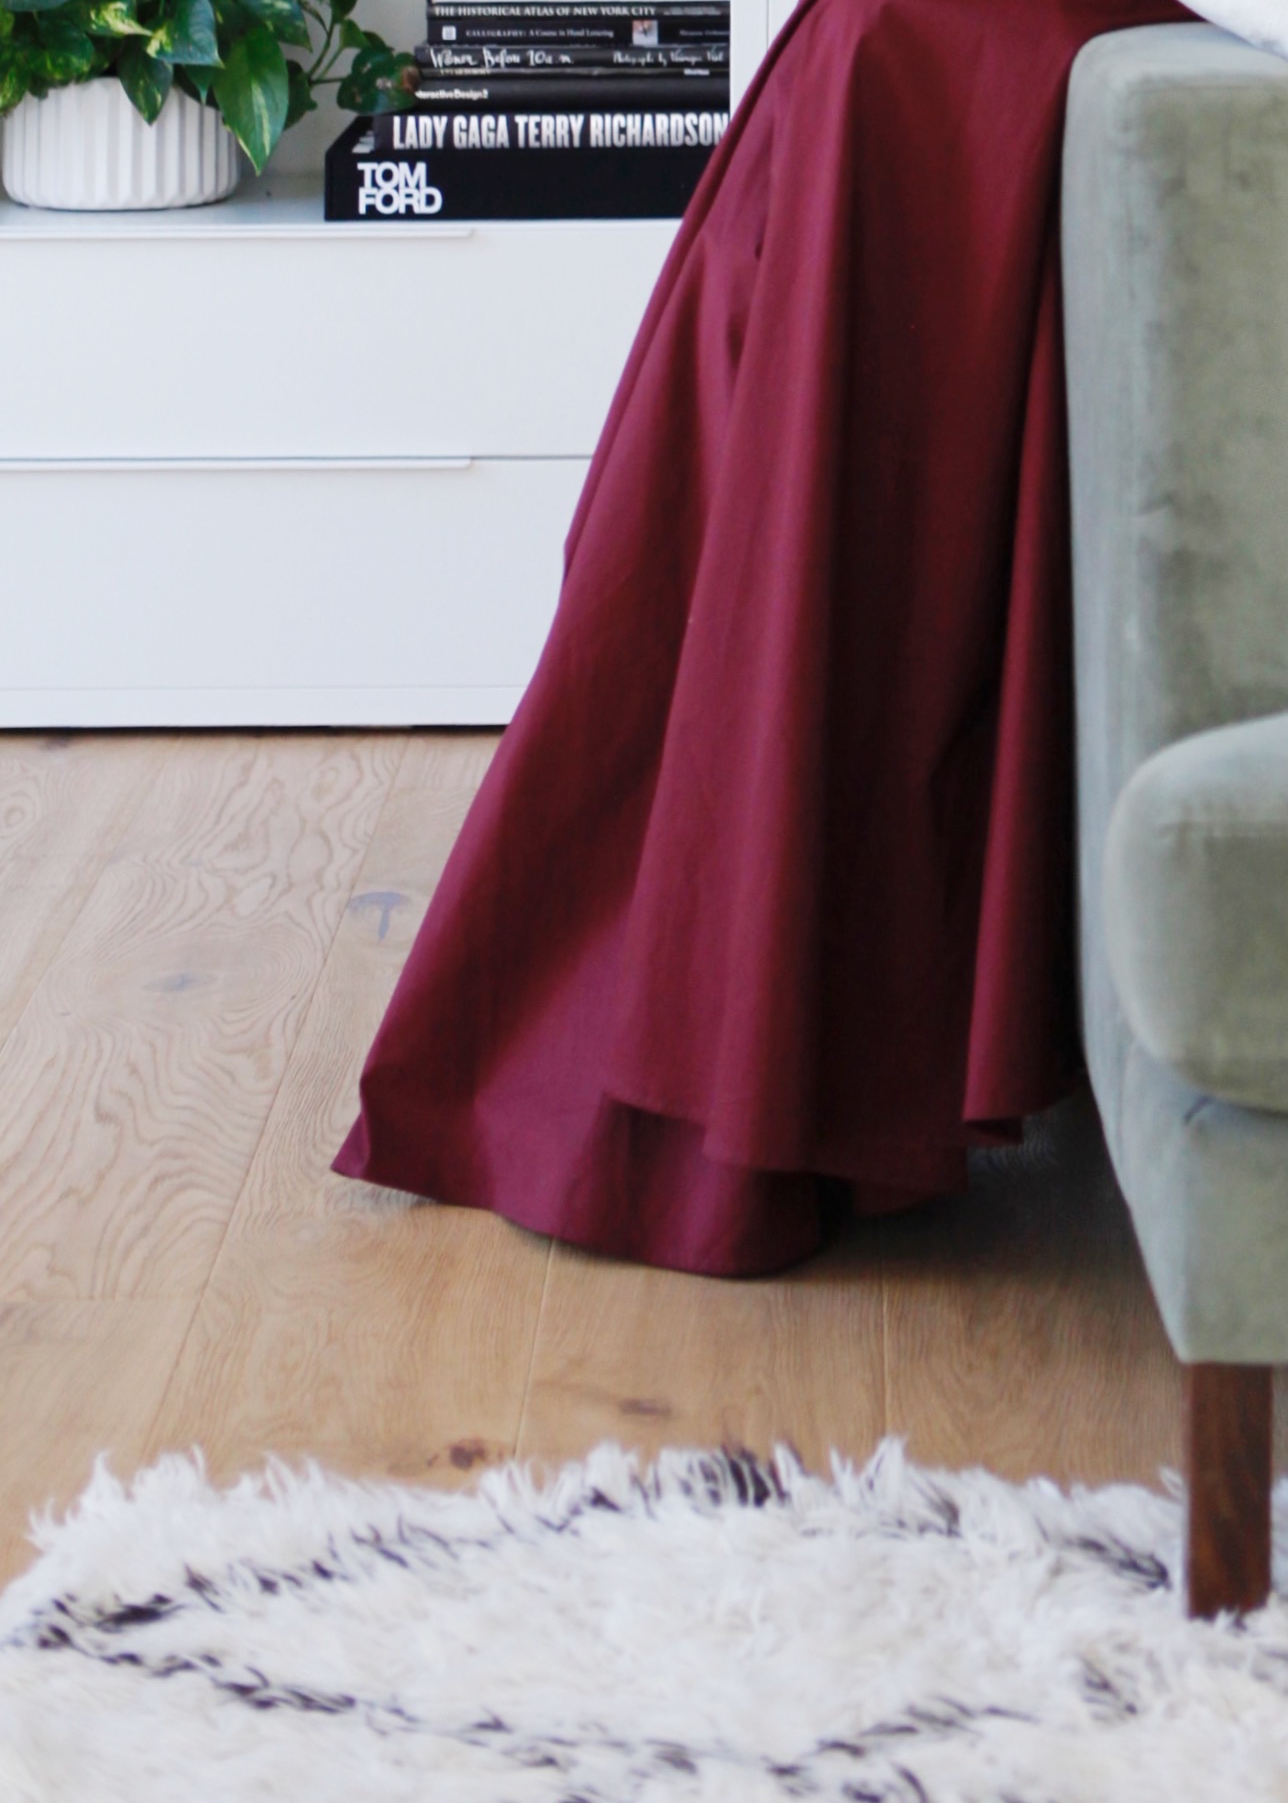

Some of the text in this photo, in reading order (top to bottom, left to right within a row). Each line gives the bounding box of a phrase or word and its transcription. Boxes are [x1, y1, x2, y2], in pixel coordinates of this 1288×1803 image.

[434, 6, 657, 17] THE HISTORICAL ATLAS OF NEW YORK CITY
[392, 111, 731, 149] LADY GAGA TERRY RICHARDSON
[356, 162, 428, 190] TOM
[357, 186, 443, 215] FORD
